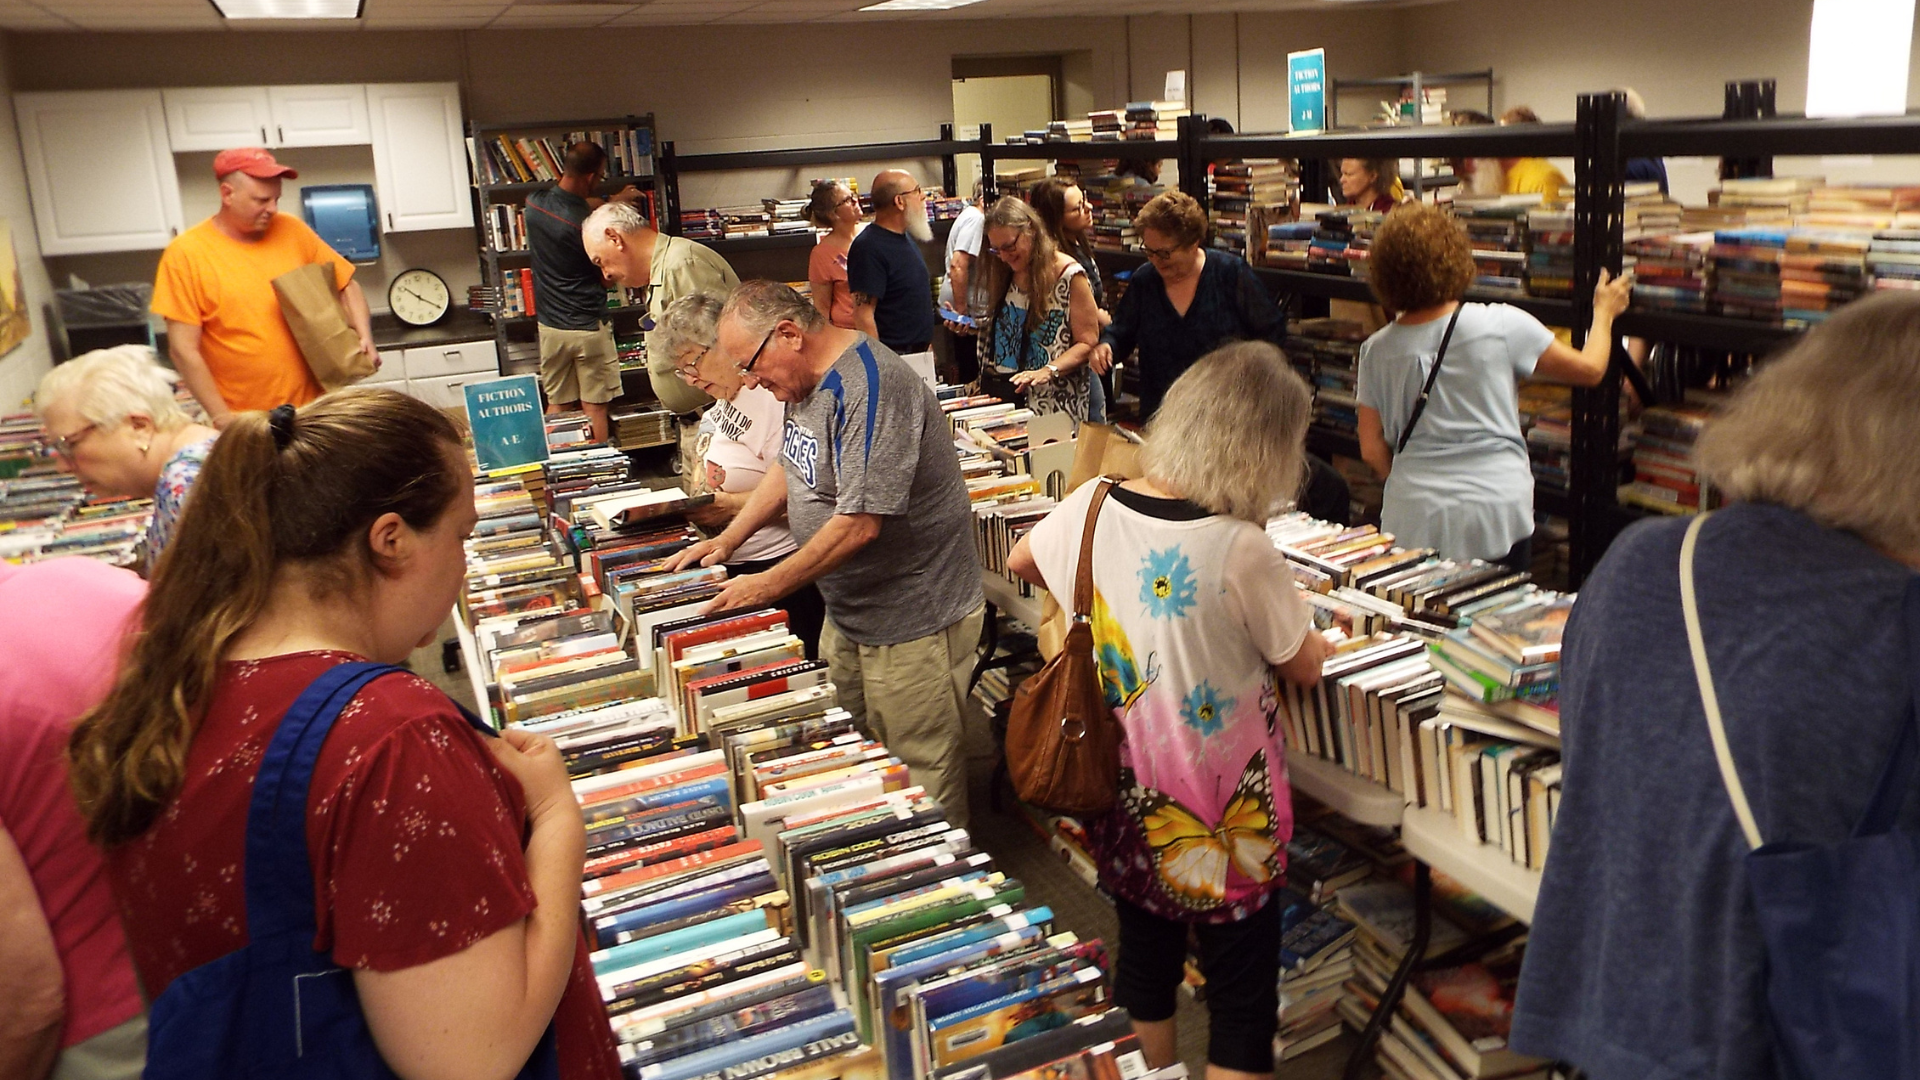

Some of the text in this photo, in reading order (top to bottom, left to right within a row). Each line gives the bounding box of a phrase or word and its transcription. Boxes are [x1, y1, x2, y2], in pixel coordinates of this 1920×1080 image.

[1294, 69, 1318, 81] FICTION
[1294, 82, 1321, 94] AUTHORS
[478, 388, 526, 403] FICTION
[478, 402, 533, 419] AUTHORS
[739, 415, 752, 431] DO
[770, 662, 816, 678] CRICHTON
[688, 806, 724, 820] DAVID
[630, 815, 687, 835] BALDACCI
[810, 847, 850, 861] ROBIN
[851, 838, 884, 852] COOK
[808, 1031, 858, 1056] DALE
[724, 1047, 804, 1080] BROWN
